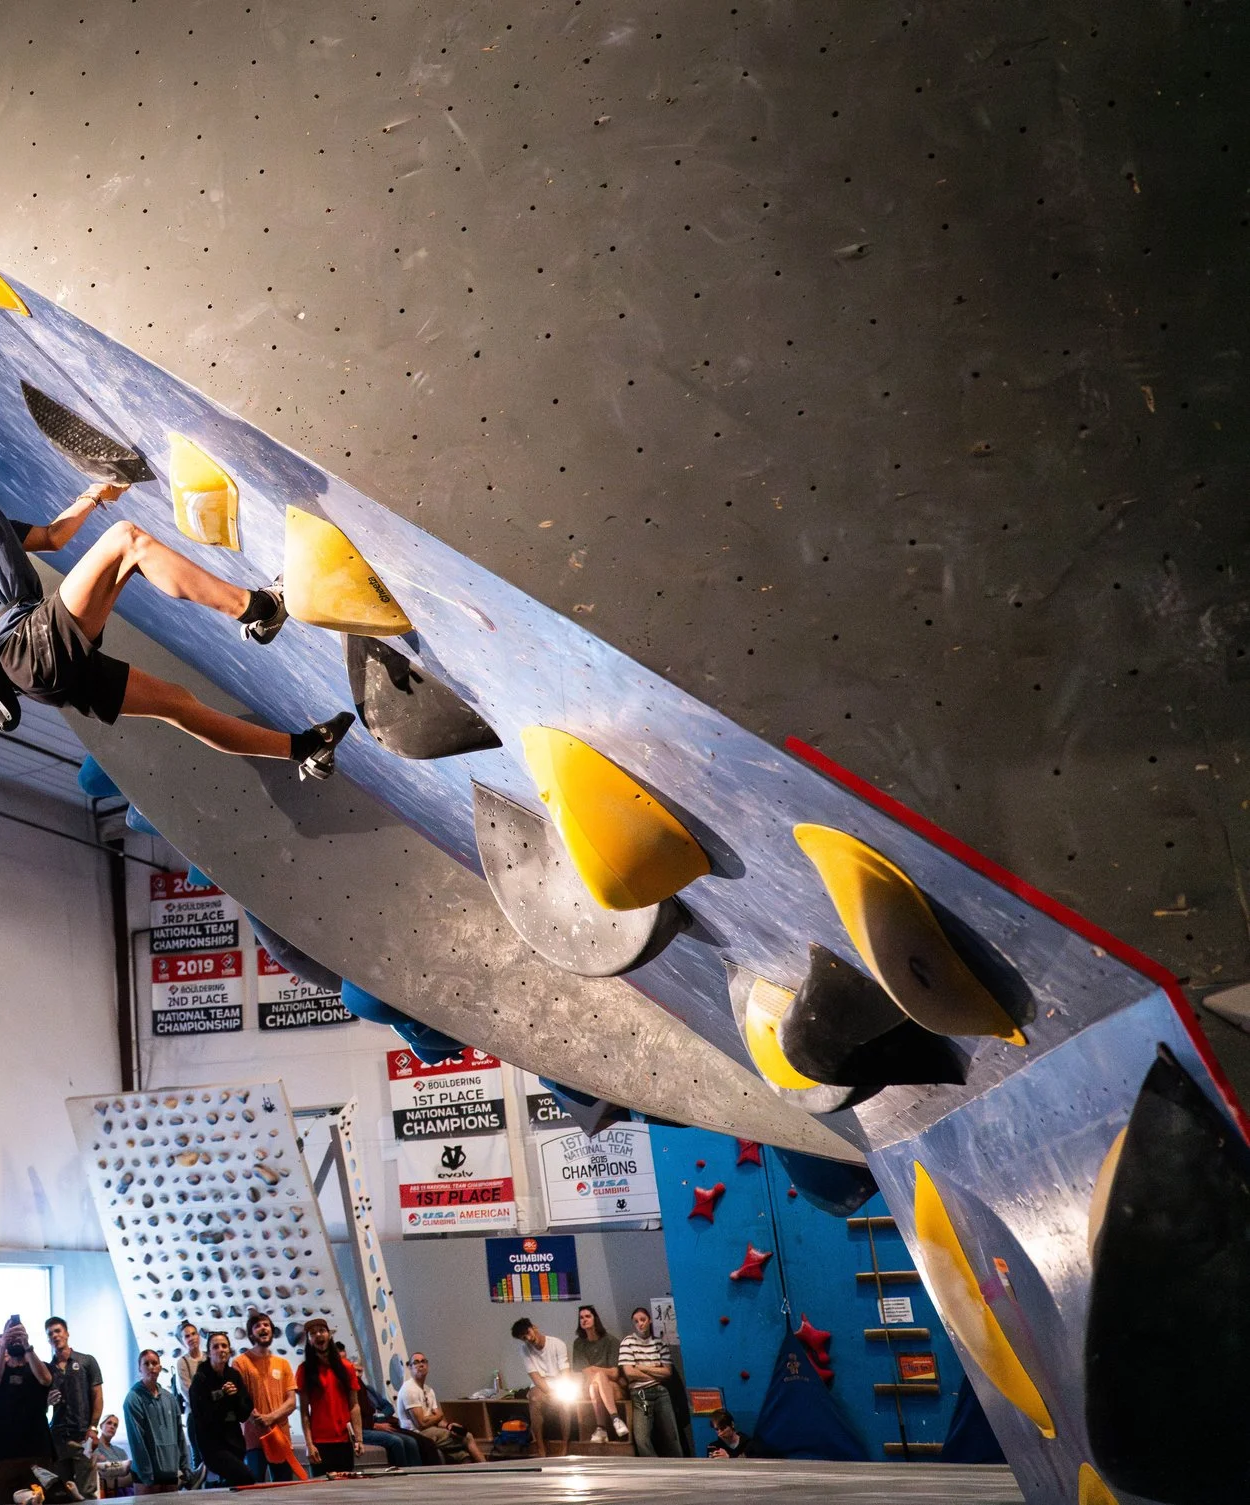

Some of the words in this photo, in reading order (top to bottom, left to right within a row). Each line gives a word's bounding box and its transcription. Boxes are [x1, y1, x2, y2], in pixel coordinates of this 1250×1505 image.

[368, 577, 390, 602] Cheeta
[178, 901, 222, 911] BOULDERING
[162, 914, 184, 924] 3RD
[187, 910, 225, 922] PLACE
[154, 926, 202, 938] NATIONAL
[206, 923, 235, 935] TEAM
[153, 935, 235, 951] CHAMPIONSHIPS
[176, 959, 215, 976] 2019
[181, 984, 225, 994] BOULDERING
[279, 989, 298, 1000] 1ST
[167, 996, 188, 1008] 2ND
[192, 993, 229, 1005] PLACE
[272, 1001, 317, 1012] NATIONAL
[157, 1011, 205, 1022] NATIONAL
[209, 1008, 240, 1020] TEAM
[266, 1008, 352, 1026] CHAMPIONS
[156, 1019, 240, 1033] CHAMPIONSHIP
[428, 1077, 481, 1090] BOULDERING
[412, 1094, 435, 1107] 1ST
[440, 1089, 484, 1104] PLACE
[406, 1107, 458, 1120] NATIONAL
[461, 1103, 492, 1115] TEAM
[403, 1114, 500, 1136] CHAMPIONS
[560, 1134, 582, 1152] 1ST
[590, 1130, 635, 1147] PLACE
[564, 1144, 606, 1163] NATIONAL
[609, 1144, 634, 1156] TEAM
[438, 1170, 474, 1179] evolv
[562, 1160, 637, 1180] CHAMPIONS
[592, 1178, 628, 1188] USA
[417, 1192, 445, 1206] 1ST
[448, 1188, 501, 1204] PLACE
[593, 1186, 630, 1196] CLIMBING
[422, 1211, 456, 1220] USA
[459, 1208, 510, 1219] AMERICAN
[422, 1218, 456, 1226] CLIMBING
[509, 1253, 554, 1263] CLIMBING
[514, 1264, 551, 1273] GRADES
